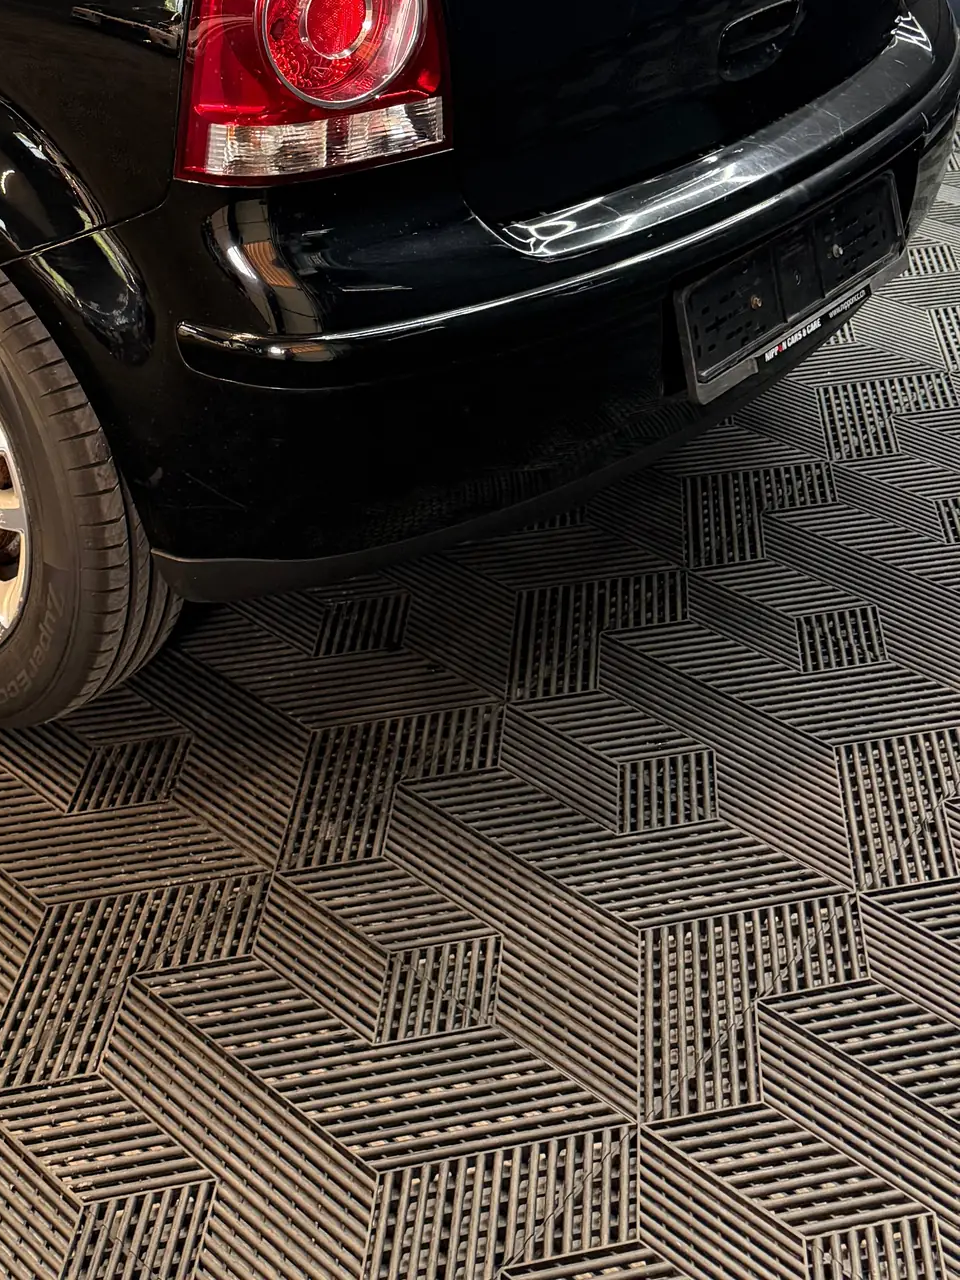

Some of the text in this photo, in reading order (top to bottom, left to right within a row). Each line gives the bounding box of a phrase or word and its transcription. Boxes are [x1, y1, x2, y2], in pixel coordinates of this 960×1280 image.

[764, 340, 787, 362] NIPPON
[787, 330, 802, 347] CARS
[806, 318, 822, 334] CARE
